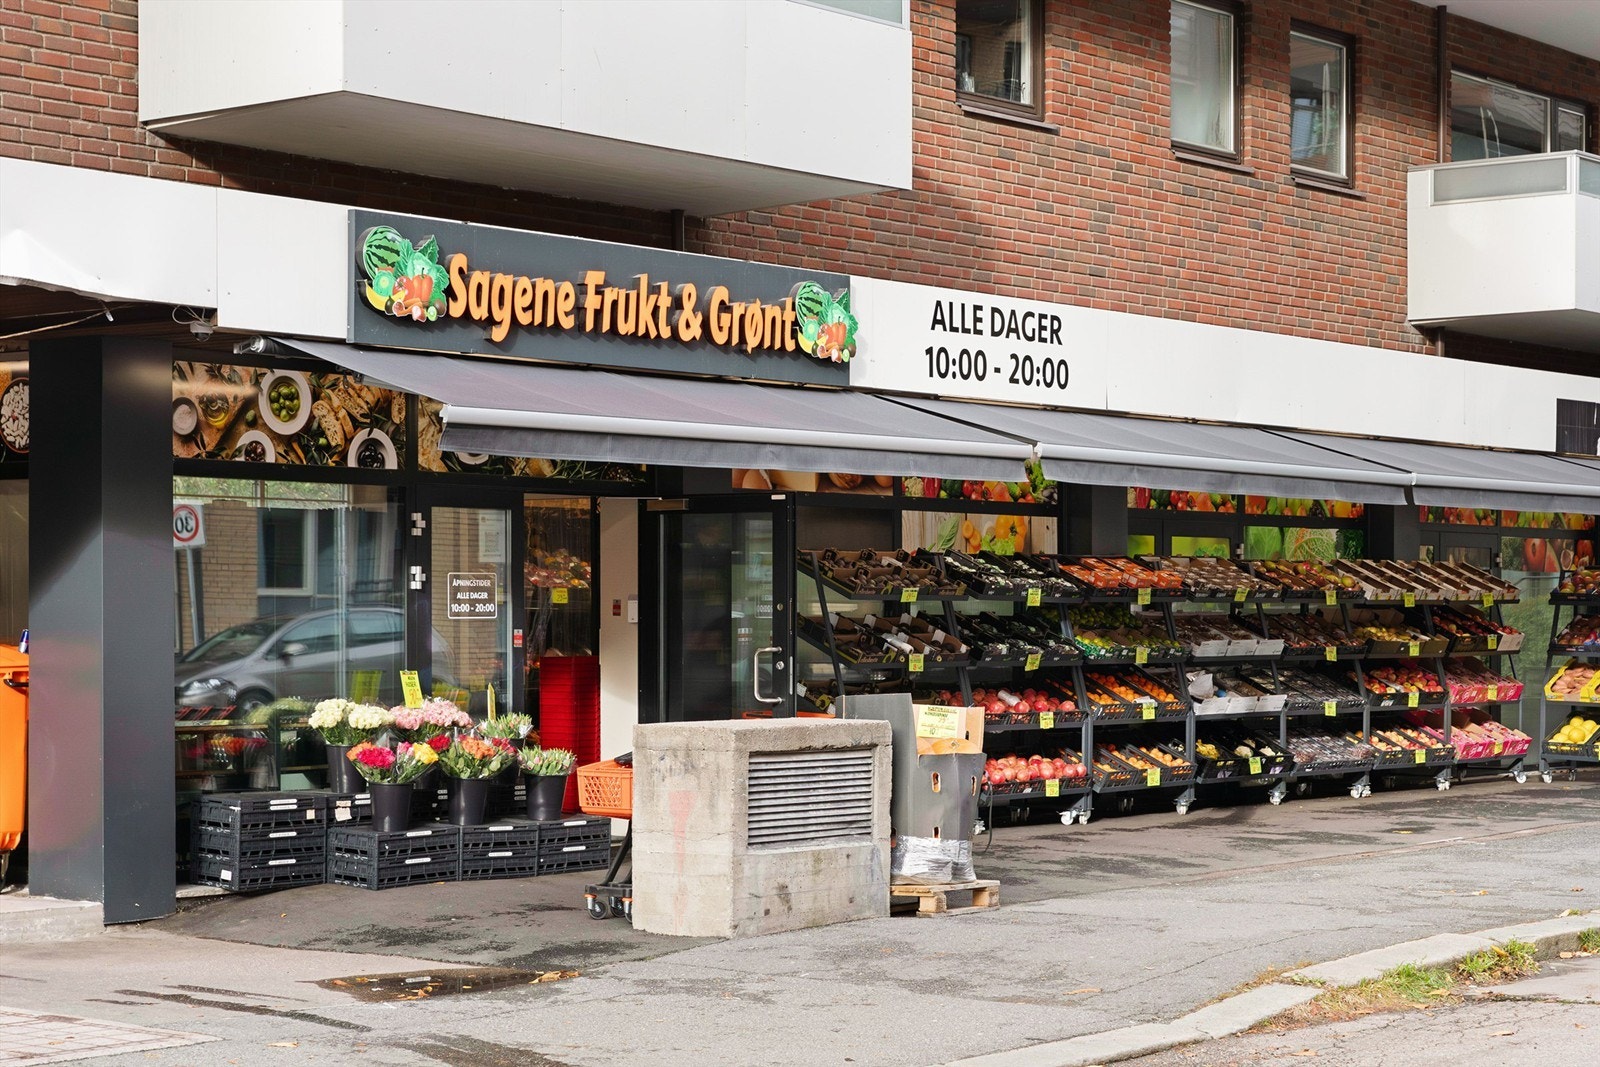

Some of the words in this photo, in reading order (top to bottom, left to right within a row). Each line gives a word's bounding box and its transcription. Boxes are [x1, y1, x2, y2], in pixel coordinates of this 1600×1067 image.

[449, 254, 576, 342] Sagene
[584, 270, 672, 338] Frukt
[678, 284, 702, 341] &
[709, 286, 797, 353] Grønt
[931, 300, 984, 336] ALLE
[990, 306, 1063, 345] DAGER
[925, 346, 987, 382] 10:00
[1008, 353, 1069, 390] 20:00
[452, 578, 491, 586] ÅPNINGSTIDER
[451, 604, 470, 612] 10:00
[475, 604, 494, 612] 20:00
